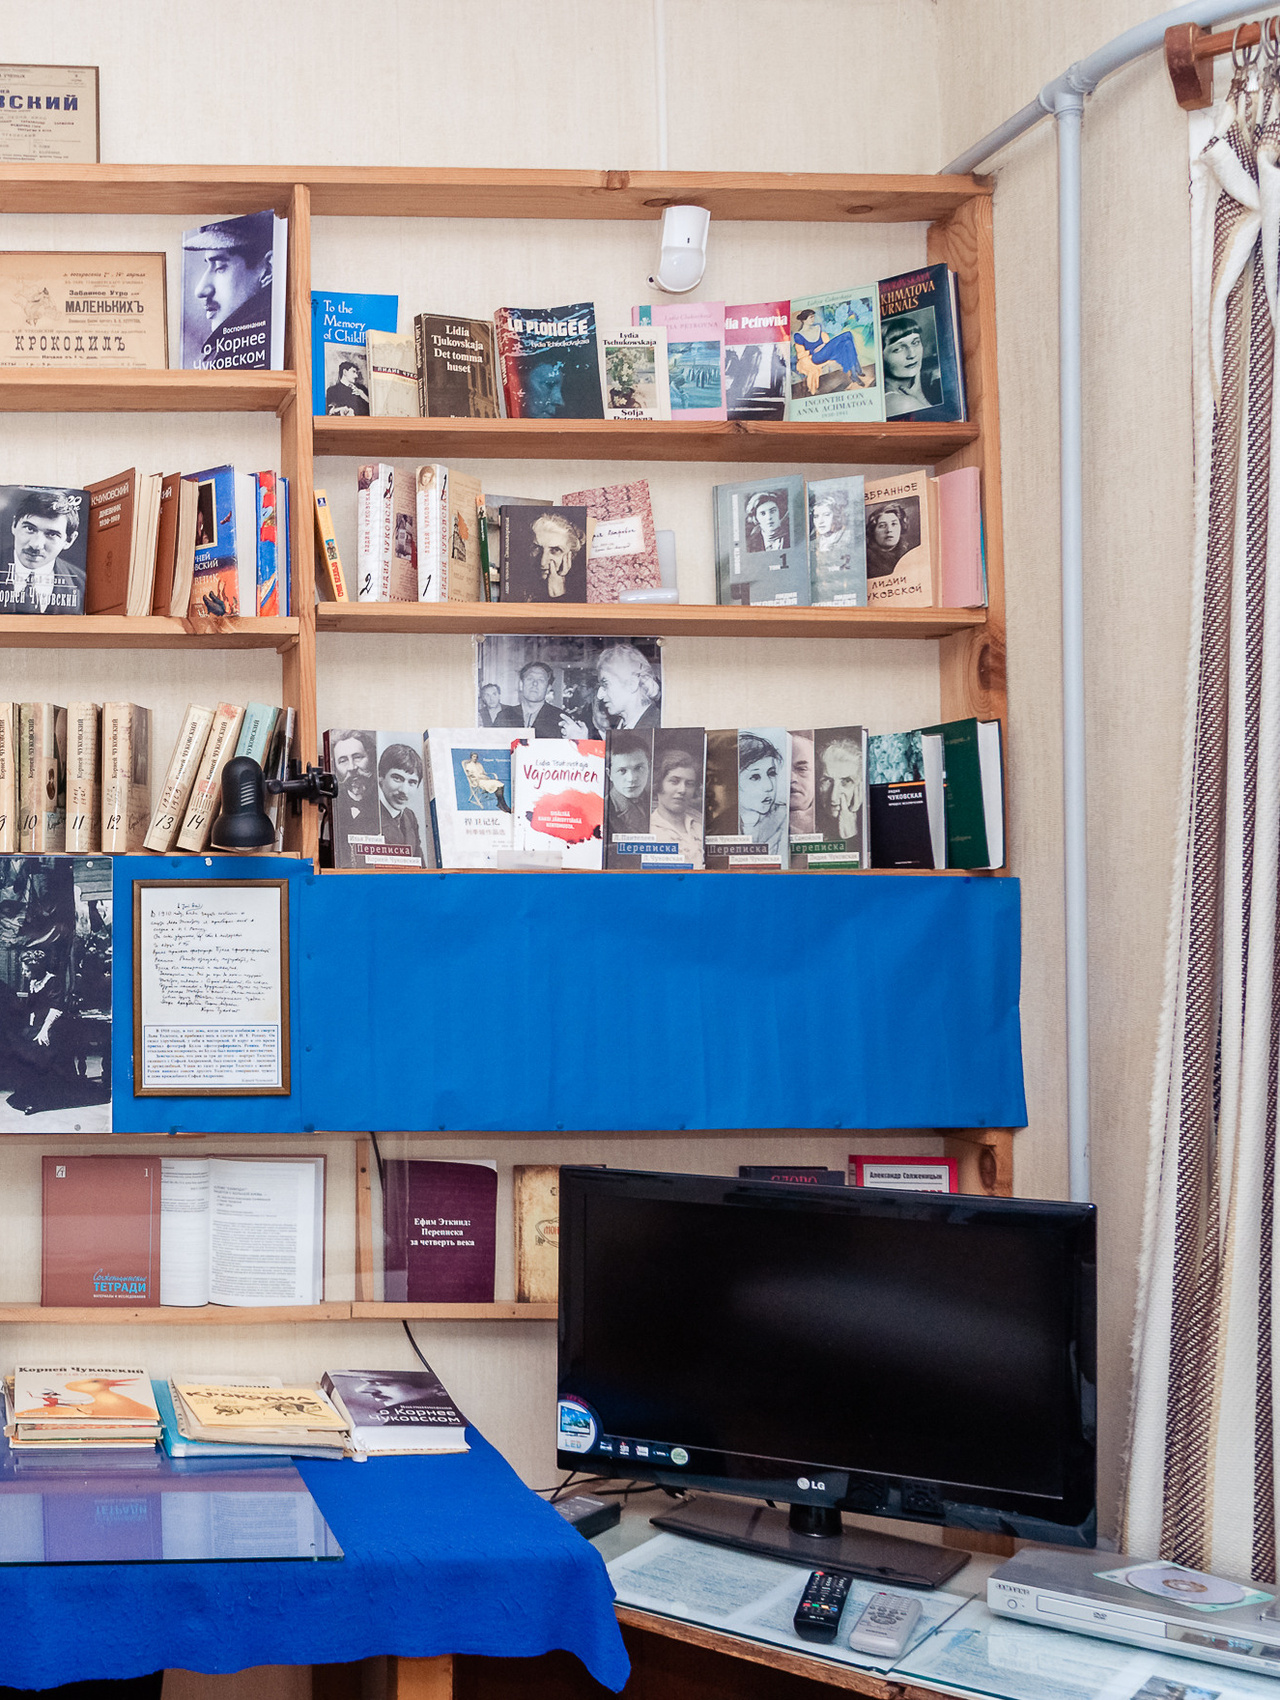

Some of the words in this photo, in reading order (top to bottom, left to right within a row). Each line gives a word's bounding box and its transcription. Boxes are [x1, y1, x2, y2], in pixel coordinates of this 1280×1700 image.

[880, 280, 936, 305] KHMATOVA
[65, 300, 144, 313] МАЛЕНЬКИХЪ
[323, 300, 336, 314] To
[338, 301, 353, 314] the
[222, 320, 267, 335] Воспоминания
[324, 316, 366, 332] Memory
[507, 317, 524, 333] LA
[741, 315, 788, 329] Petrovna
[323, 331, 332, 342] of
[445, 324, 470, 337] Lidia
[619, 332, 639, 340] Lydia
[15, 336, 126, 352] КРОКОДИЛЪ
[203, 344, 213, 356] о
[215, 333, 266, 353] Корнее
[430, 335, 484, 352] Tjukovskaja
[602, 339, 657, 347] Tschukowskaja
[193, 350, 266, 370] Чуковском
[434, 348, 450, 360] Det
[452, 352, 483, 363] tomma
[446, 360, 471, 374] huset
[805, 396, 845, 407] INCONTRI
[847, 392, 864, 402] CON
[797, 406, 819, 416] ANNA
[822, 399, 874, 412] ACHMATOVA
[780, 553, 789, 569] 1
[839, 554, 851, 570] 2
[872, 576, 907, 589] ЛИДИИ
[524, 764, 598, 789] Vajoaminen
[888, 792, 922, 800] ЧУКОВСКАЯ
[23, 814, 38, 830] 10
[186, 814, 204, 830] 14
[357, 844, 410, 854] Переписка
[619, 843, 677, 854] Переписка
[709, 845, 768, 855] Переписка
[870, 1171, 901, 1179] Александр
[414, 1218, 437, 1227] Ефим
[438, 1218, 471, 1226] Эткинд:
[422, 1228, 463, 1237] Переписка
[94, 1282, 146, 1293] ТЕТРАДИ
[369, 1413, 461, 1425] Чуковском
[394, 1408, 456, 1420] Корнее
[811, 1480, 826, 1490] LG
